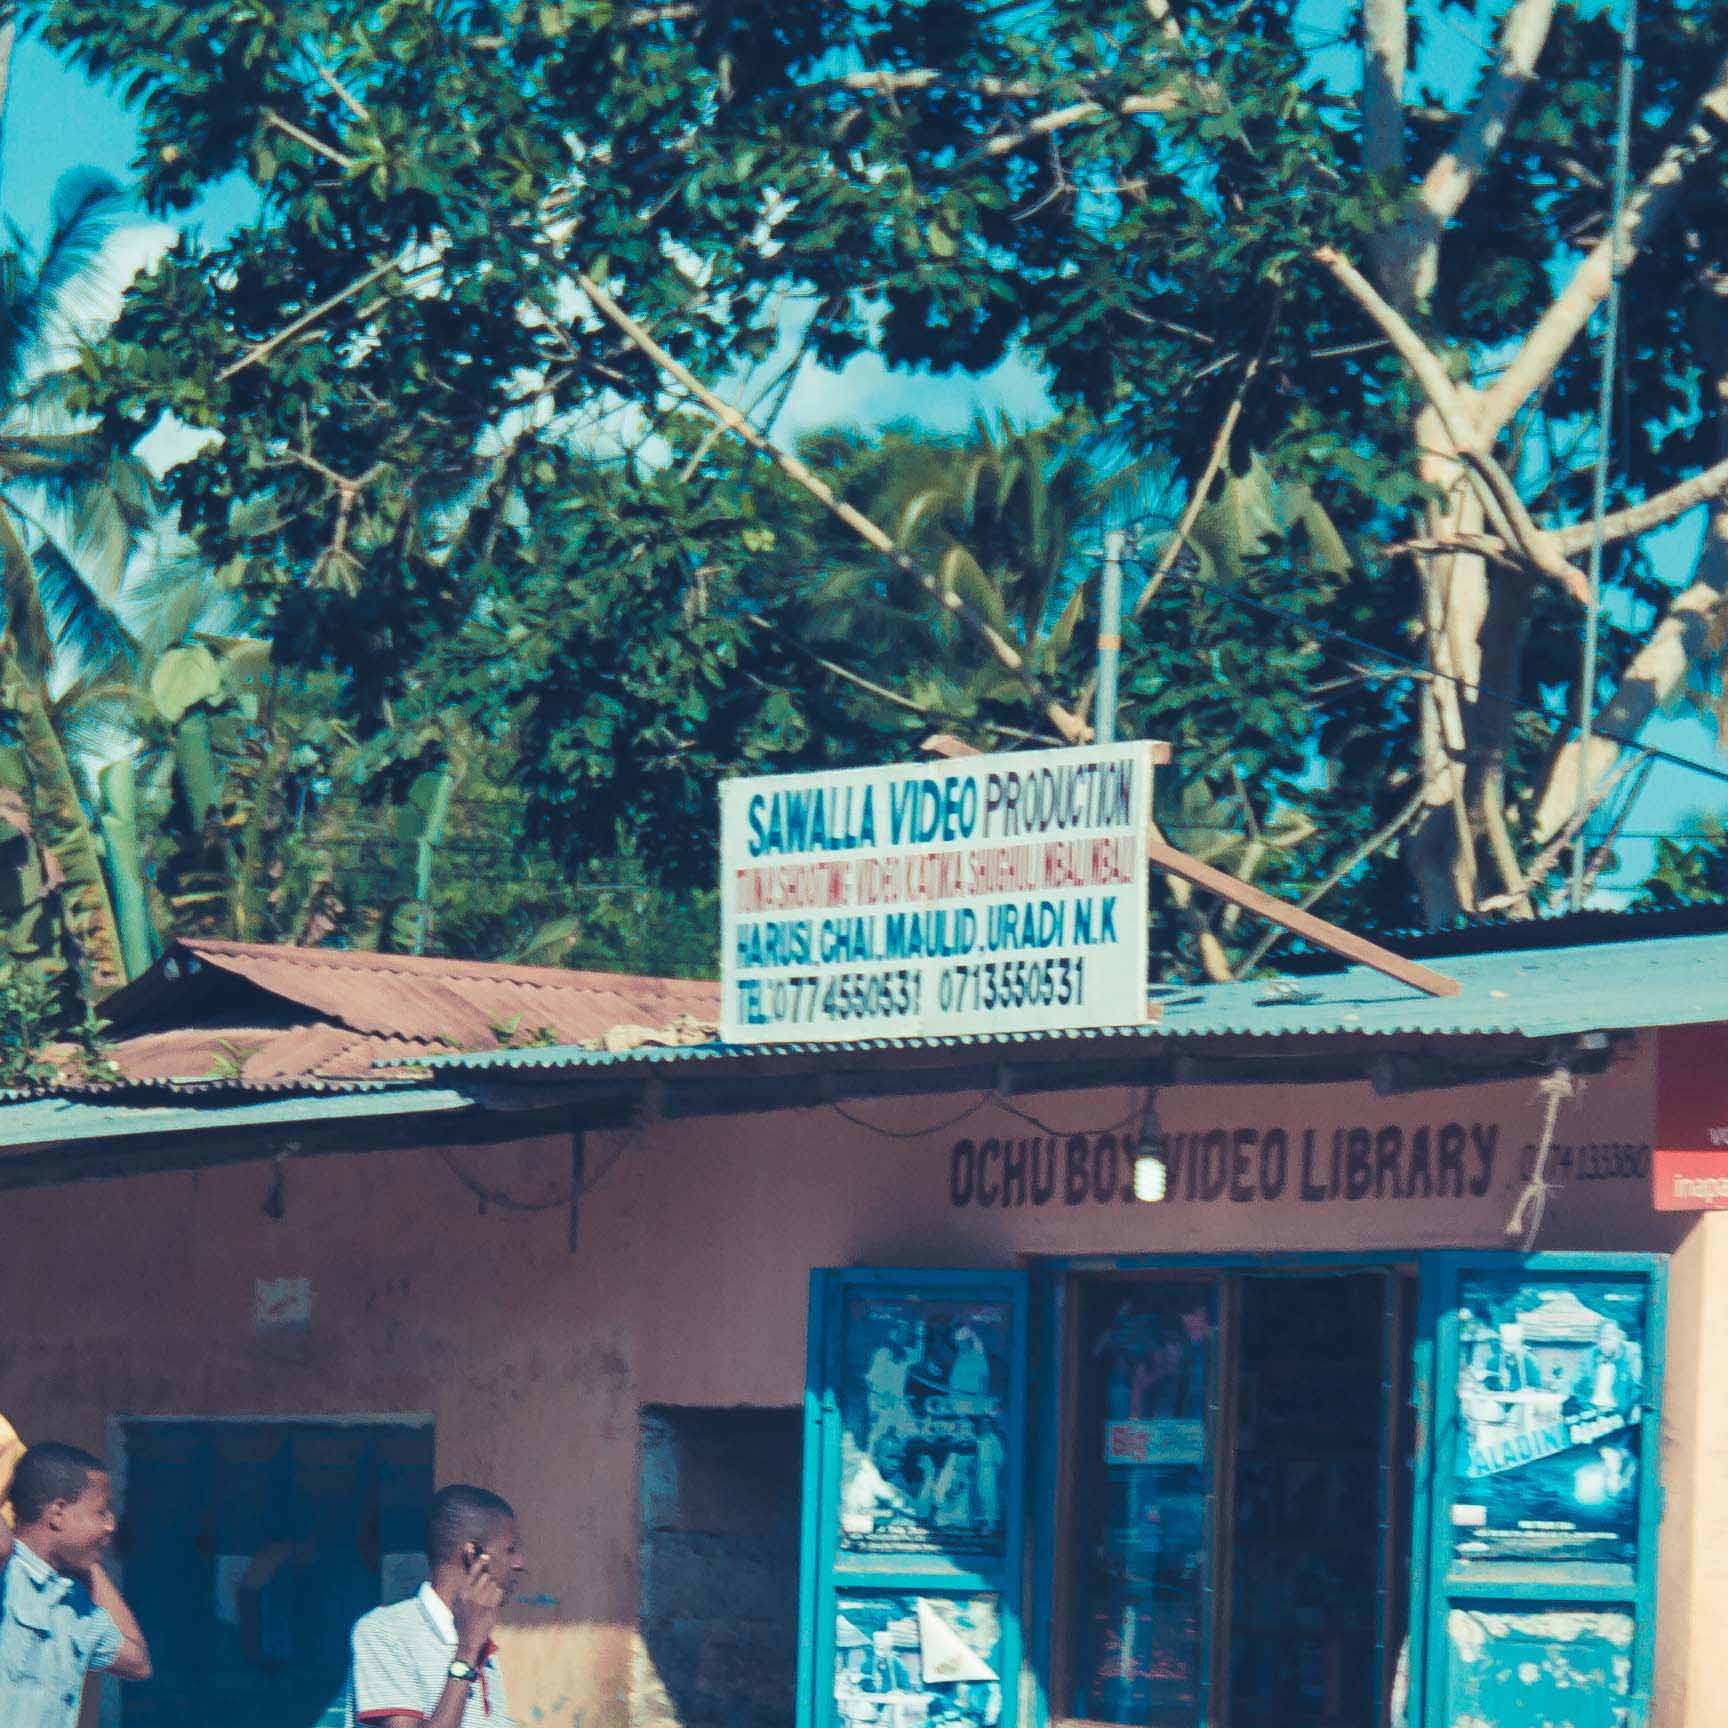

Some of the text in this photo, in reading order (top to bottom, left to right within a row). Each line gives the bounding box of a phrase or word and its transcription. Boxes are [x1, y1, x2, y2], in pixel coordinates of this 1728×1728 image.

[890, 776, 977, 844] VIDEO
[983, 759, 1134, 837] PRODUCTION
[950, 1137, 1054, 1207] OCHU
[1162, 1128, 1287, 1202] VIDEO
[1300, 1122, 1498, 1202] LIBRARY
